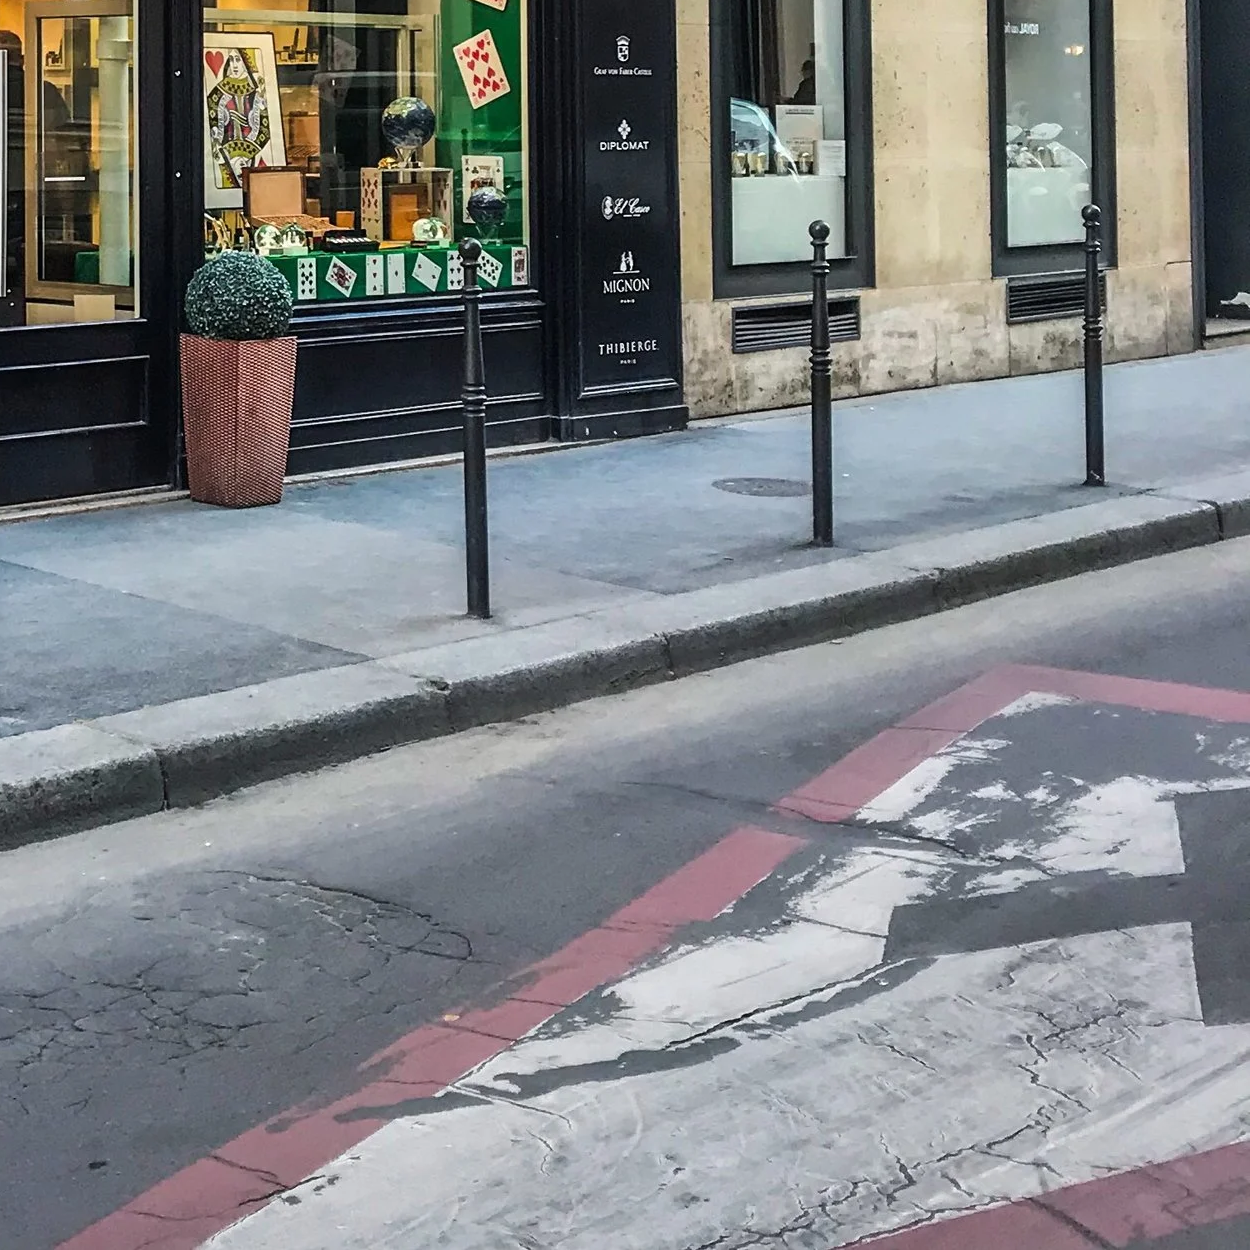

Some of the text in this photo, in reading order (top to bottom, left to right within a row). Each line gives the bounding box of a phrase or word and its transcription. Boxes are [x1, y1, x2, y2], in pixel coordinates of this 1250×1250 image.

[600, 140, 649, 150] DIPLOMAT
[603, 278, 650, 294] MIGNON
[598, 340, 657, 355] THIBIERGE
